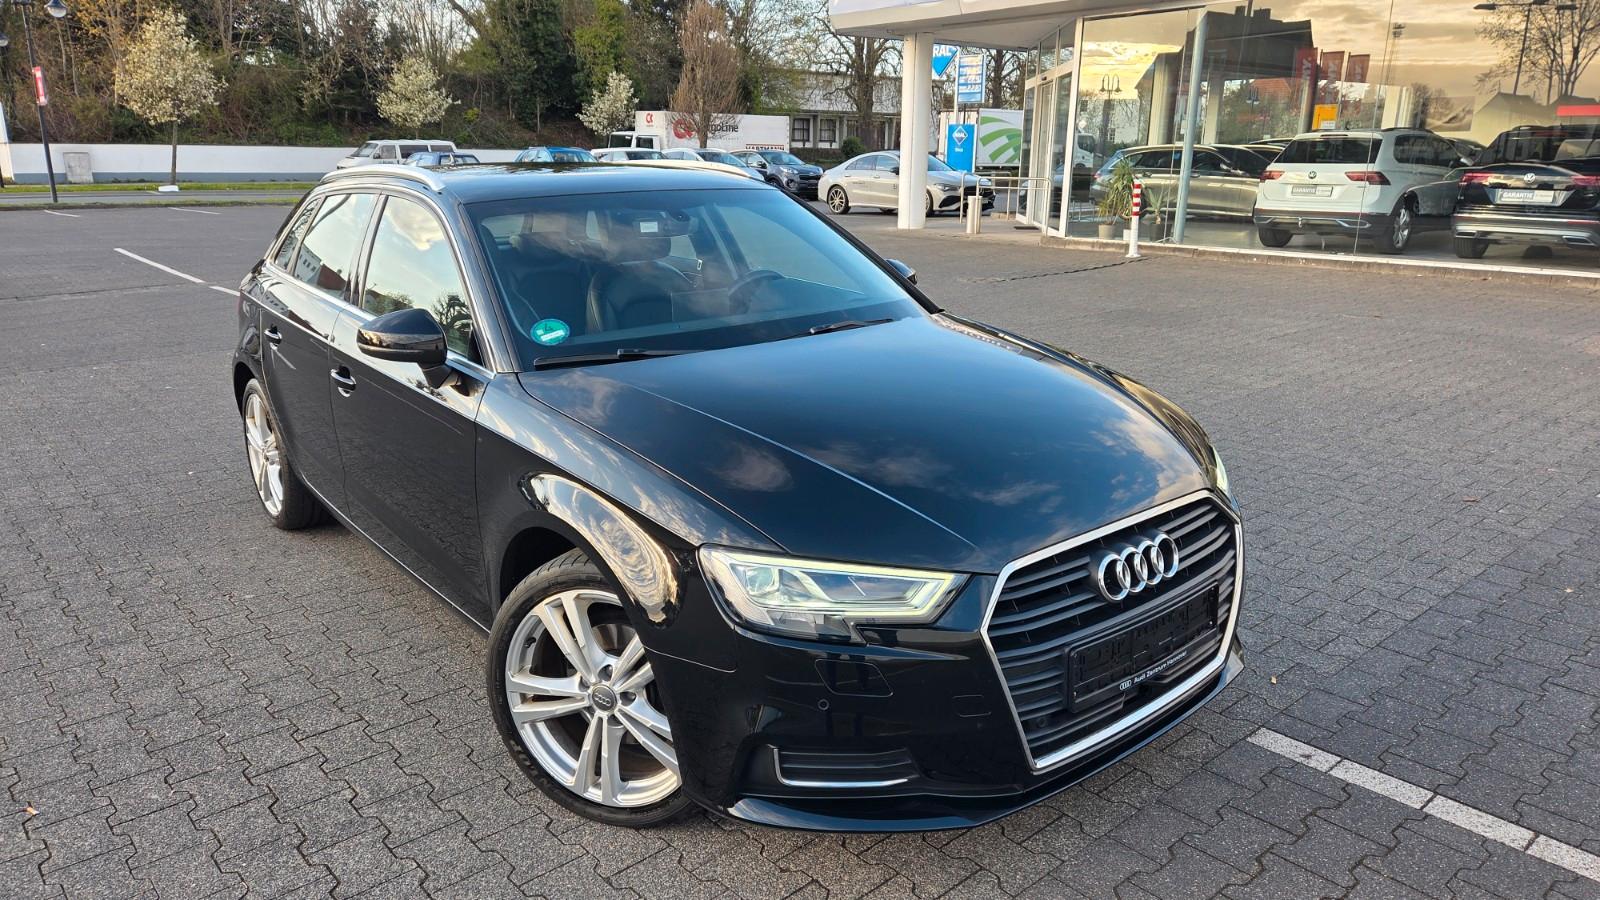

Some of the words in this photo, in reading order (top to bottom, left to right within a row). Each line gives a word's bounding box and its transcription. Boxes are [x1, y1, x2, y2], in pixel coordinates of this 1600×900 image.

[932, 45, 952, 57] RAL
[1502, 190, 1534, 199] GARANTIE
[1133, 673, 1146, 684] Audi
[1146, 662, 1168, 678] Zentrum
[1166, 650, 1188, 667] Hannover
